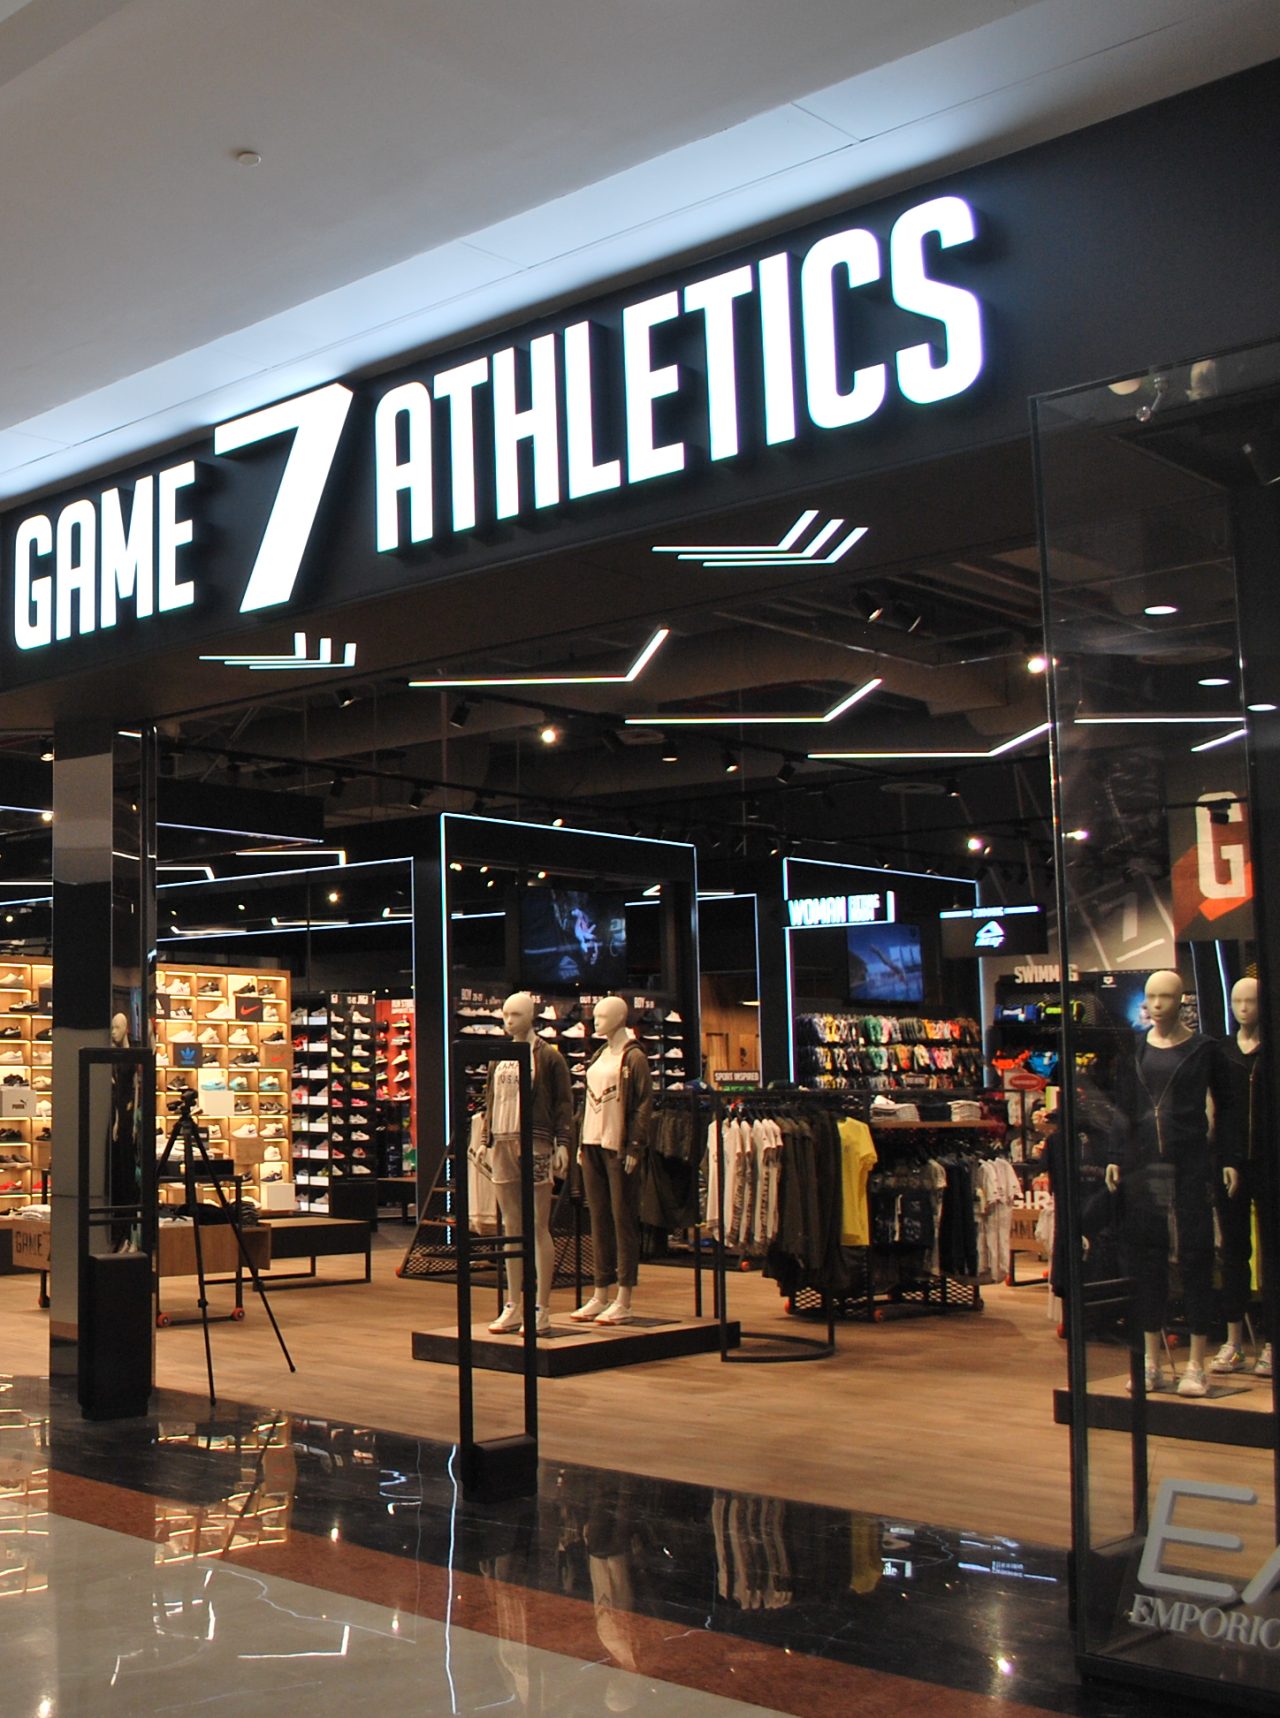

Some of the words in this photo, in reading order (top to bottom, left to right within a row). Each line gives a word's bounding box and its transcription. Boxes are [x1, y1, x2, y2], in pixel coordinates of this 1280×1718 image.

[13, 459, 196, 651] GAME
[214, 382, 354, 613] 7
[374, 195, 984, 553] ATHLETICS
[1195, 791, 1246, 899] G
[790, 896, 846, 926] WOMAN
[1014, 964, 1079, 983] SWIMMG
